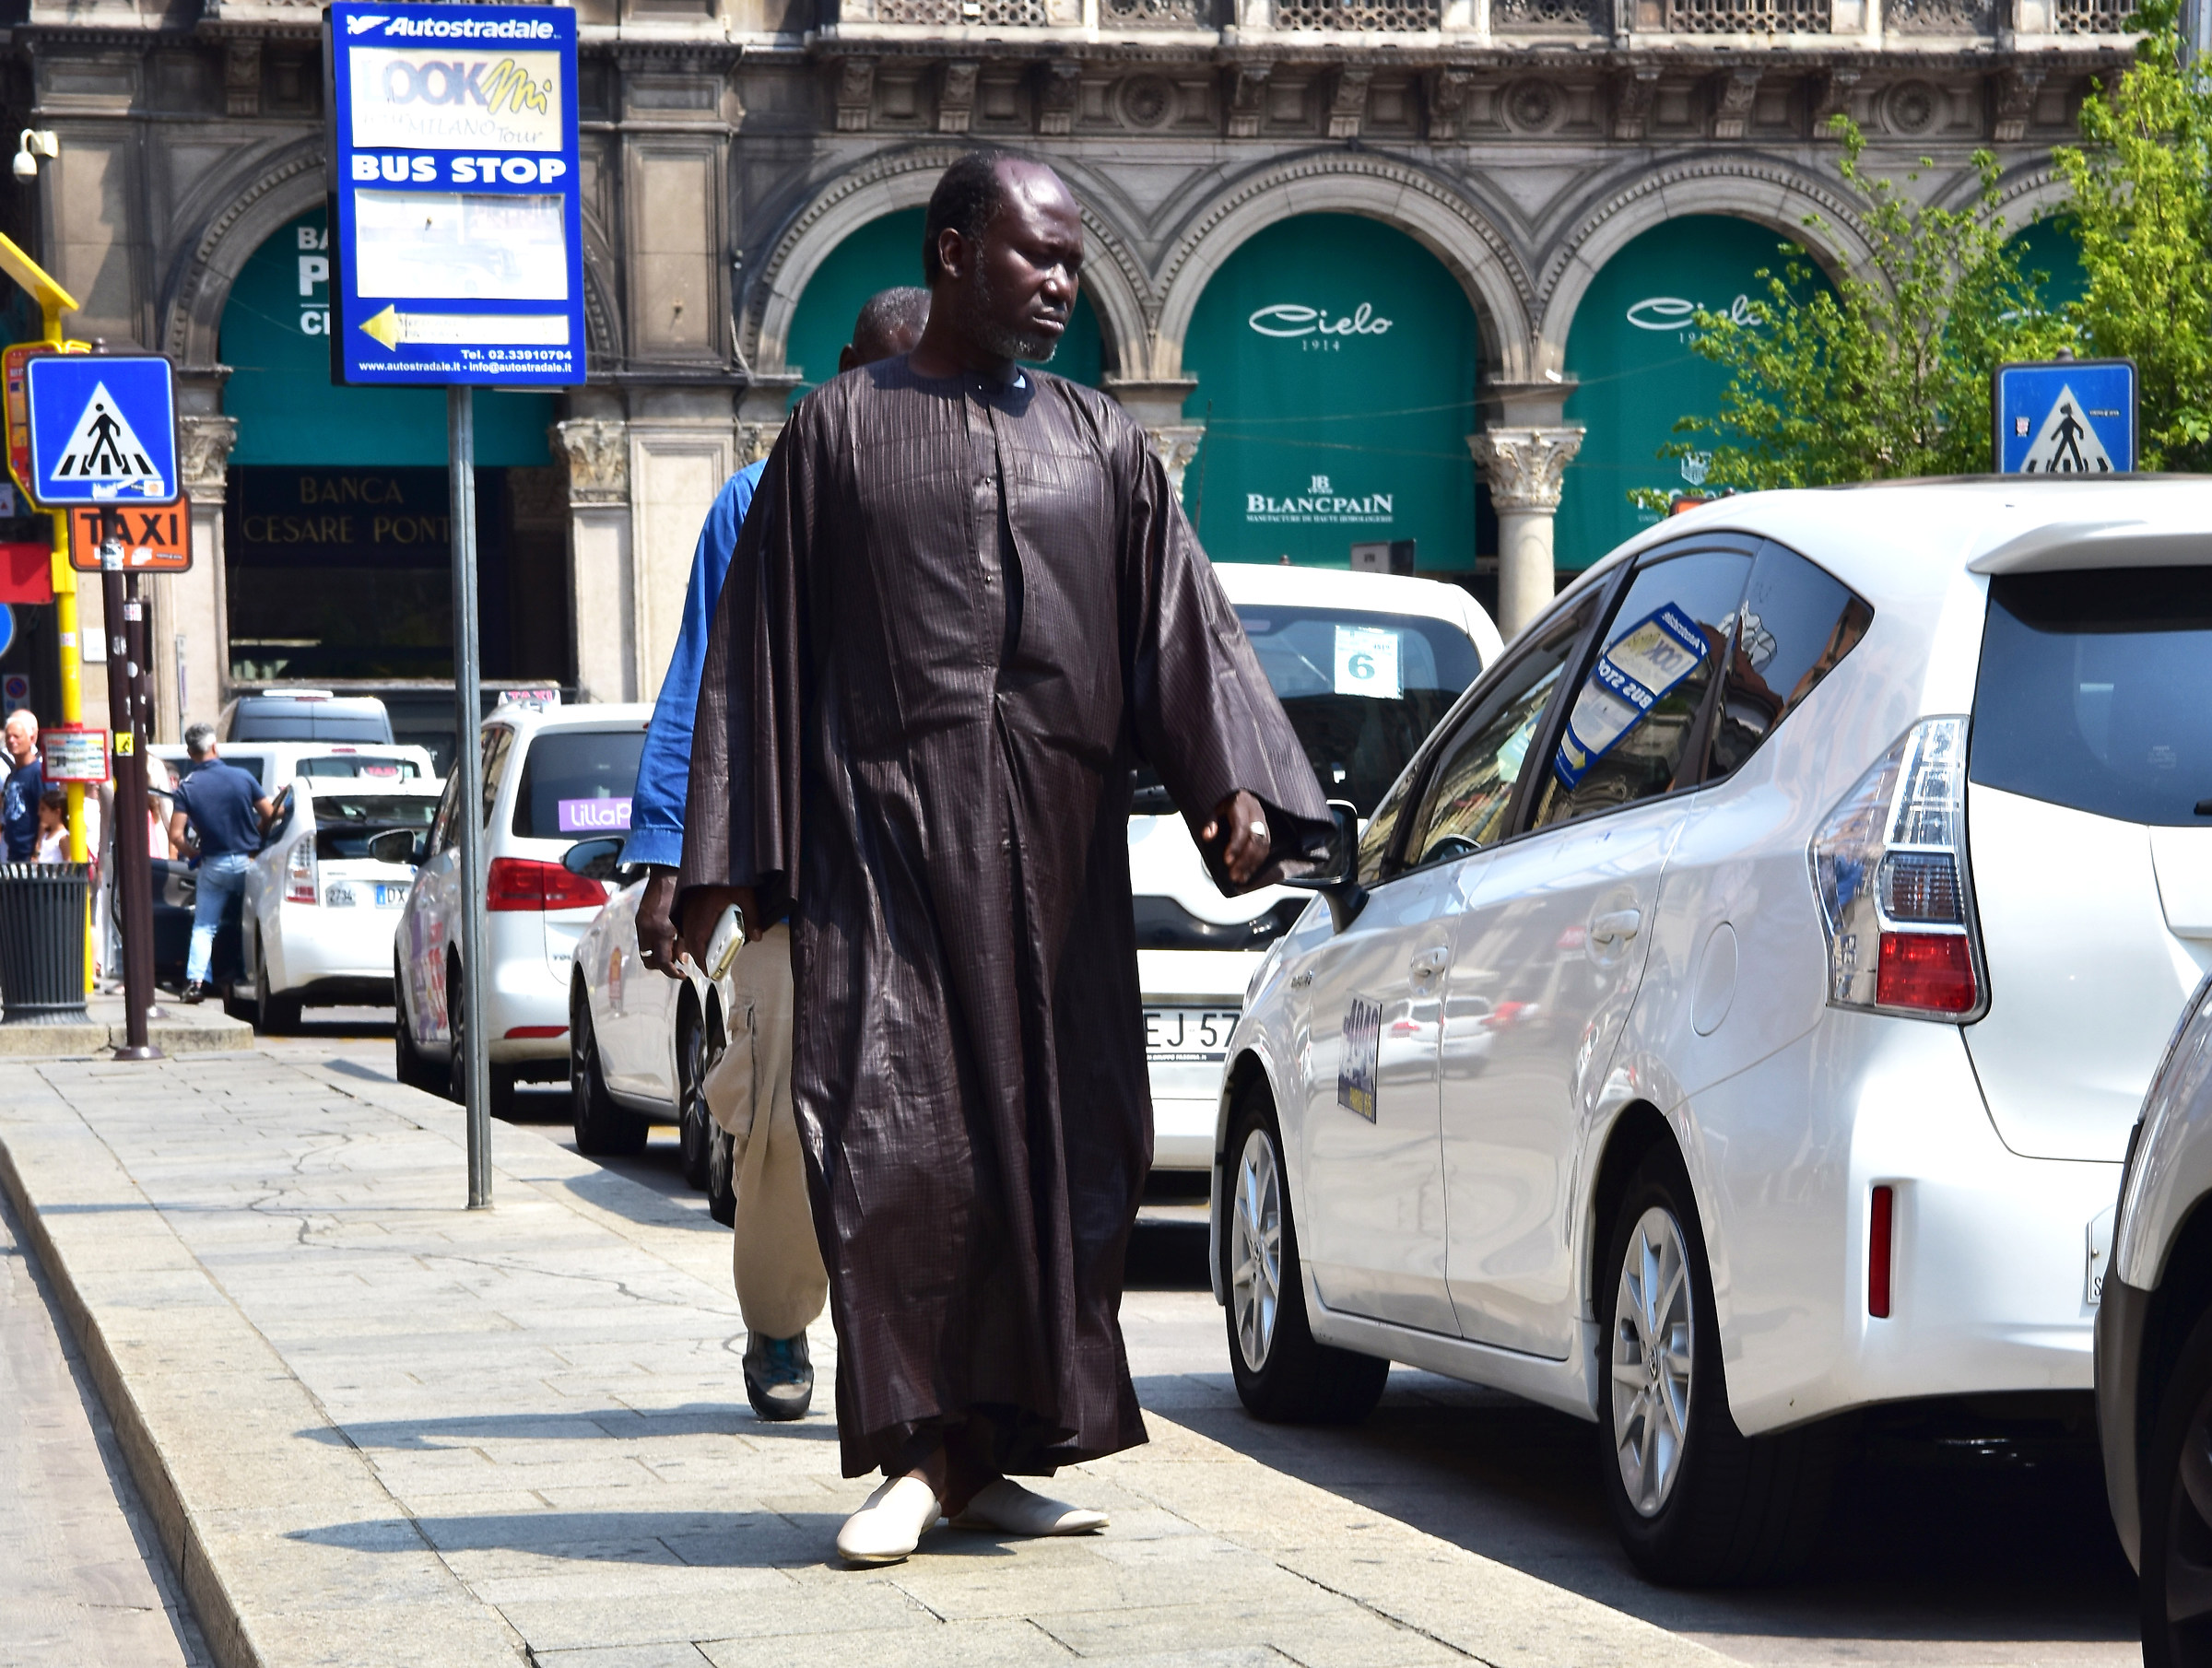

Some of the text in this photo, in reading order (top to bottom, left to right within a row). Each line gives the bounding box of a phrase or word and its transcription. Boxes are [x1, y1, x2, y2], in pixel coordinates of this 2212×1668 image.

[384, 17, 553, 39] Autostradale
[351, 155, 567, 184] BUS STOP
[1249, 302, 1393, 337] Cielo
[460, 349, 485, 360] Tel.
[1302, 339, 1340, 352] 1914
[300, 476, 404, 504] BANCA
[80, 513, 179, 546] TAXI
[243, 516, 451, 543] CESARE PONT
[1348, 653, 1375, 680] 6
[388, 887, 405, 903] DX
